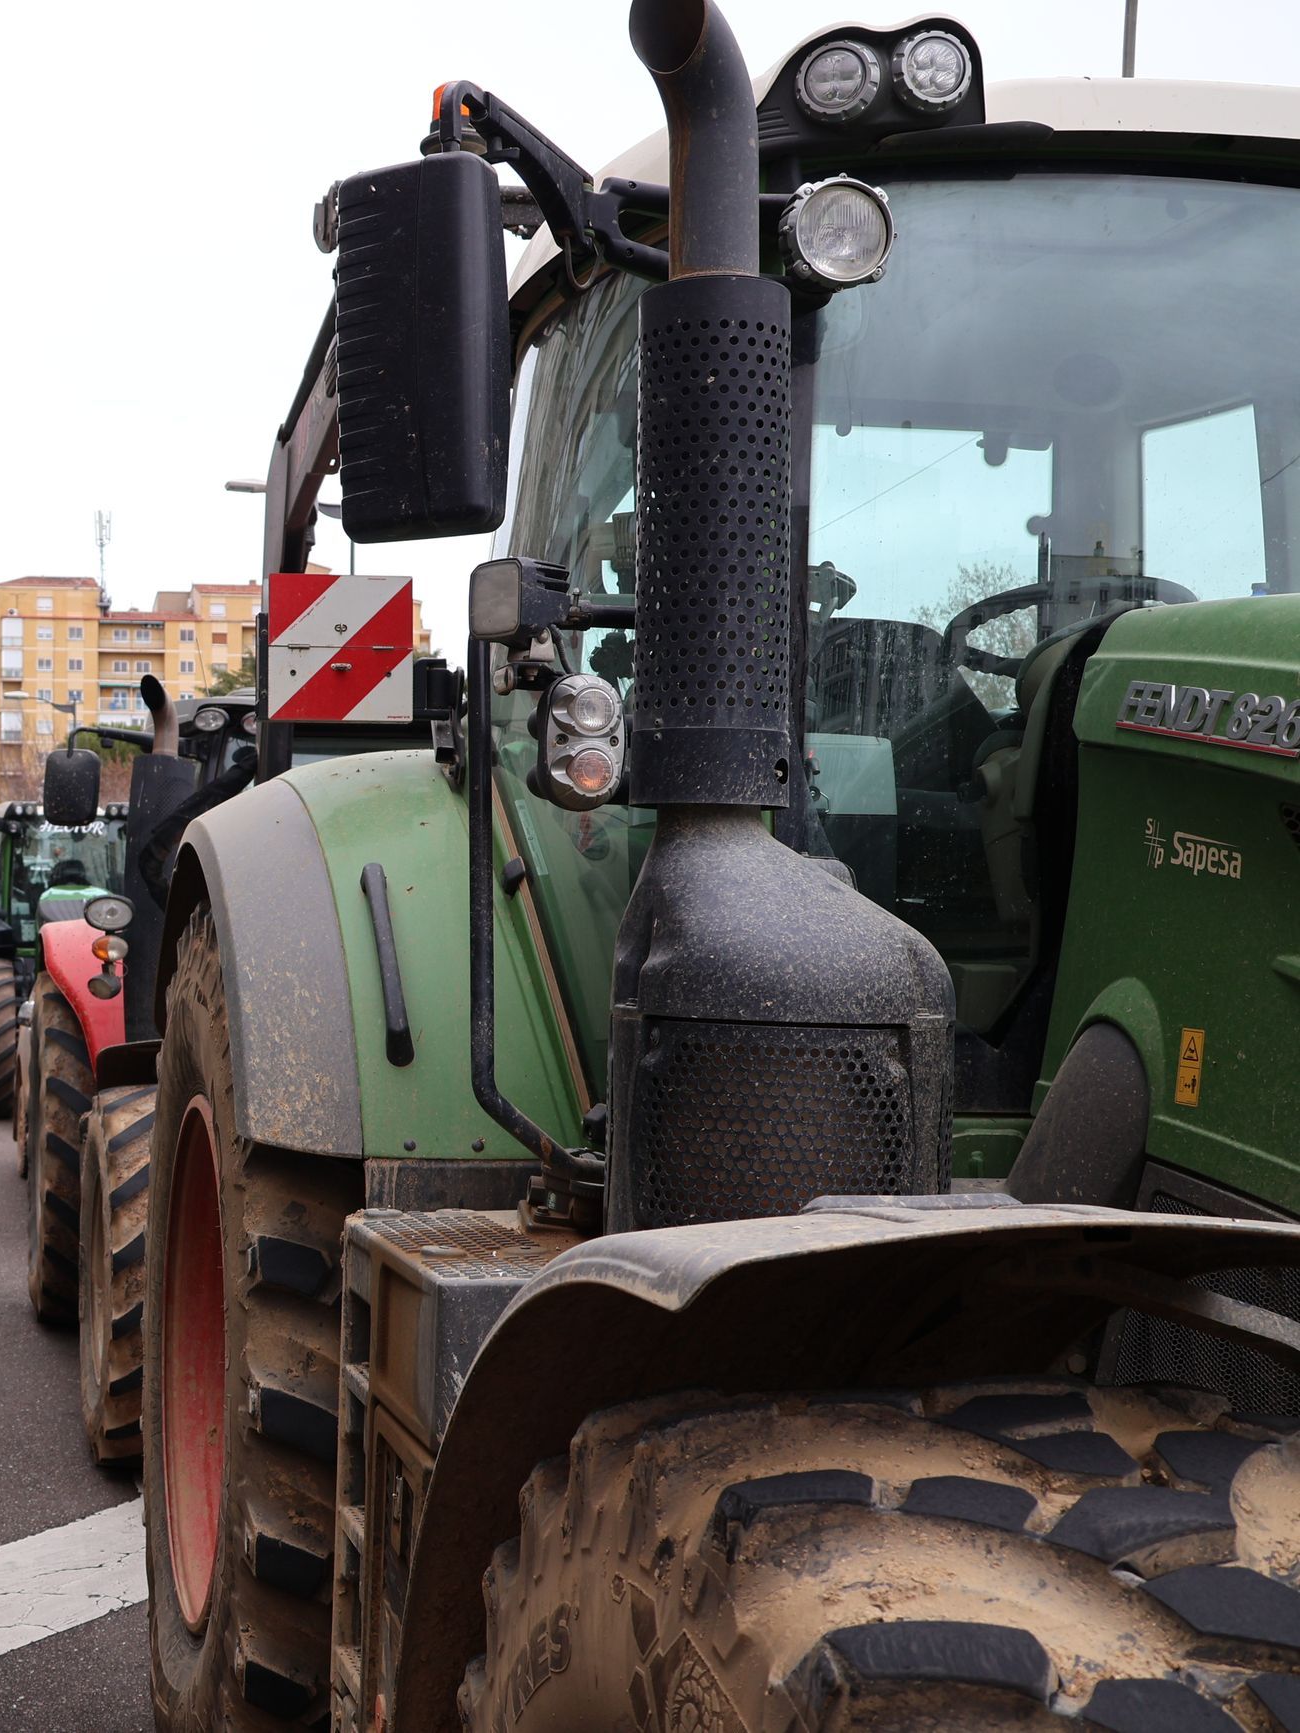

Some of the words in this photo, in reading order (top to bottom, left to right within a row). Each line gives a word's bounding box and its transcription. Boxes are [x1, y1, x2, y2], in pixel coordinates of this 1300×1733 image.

[1117, 680, 1235, 735] FENDT
[1226, 692, 1300, 749] 826
[1170, 831, 1242, 879] Sapesa
